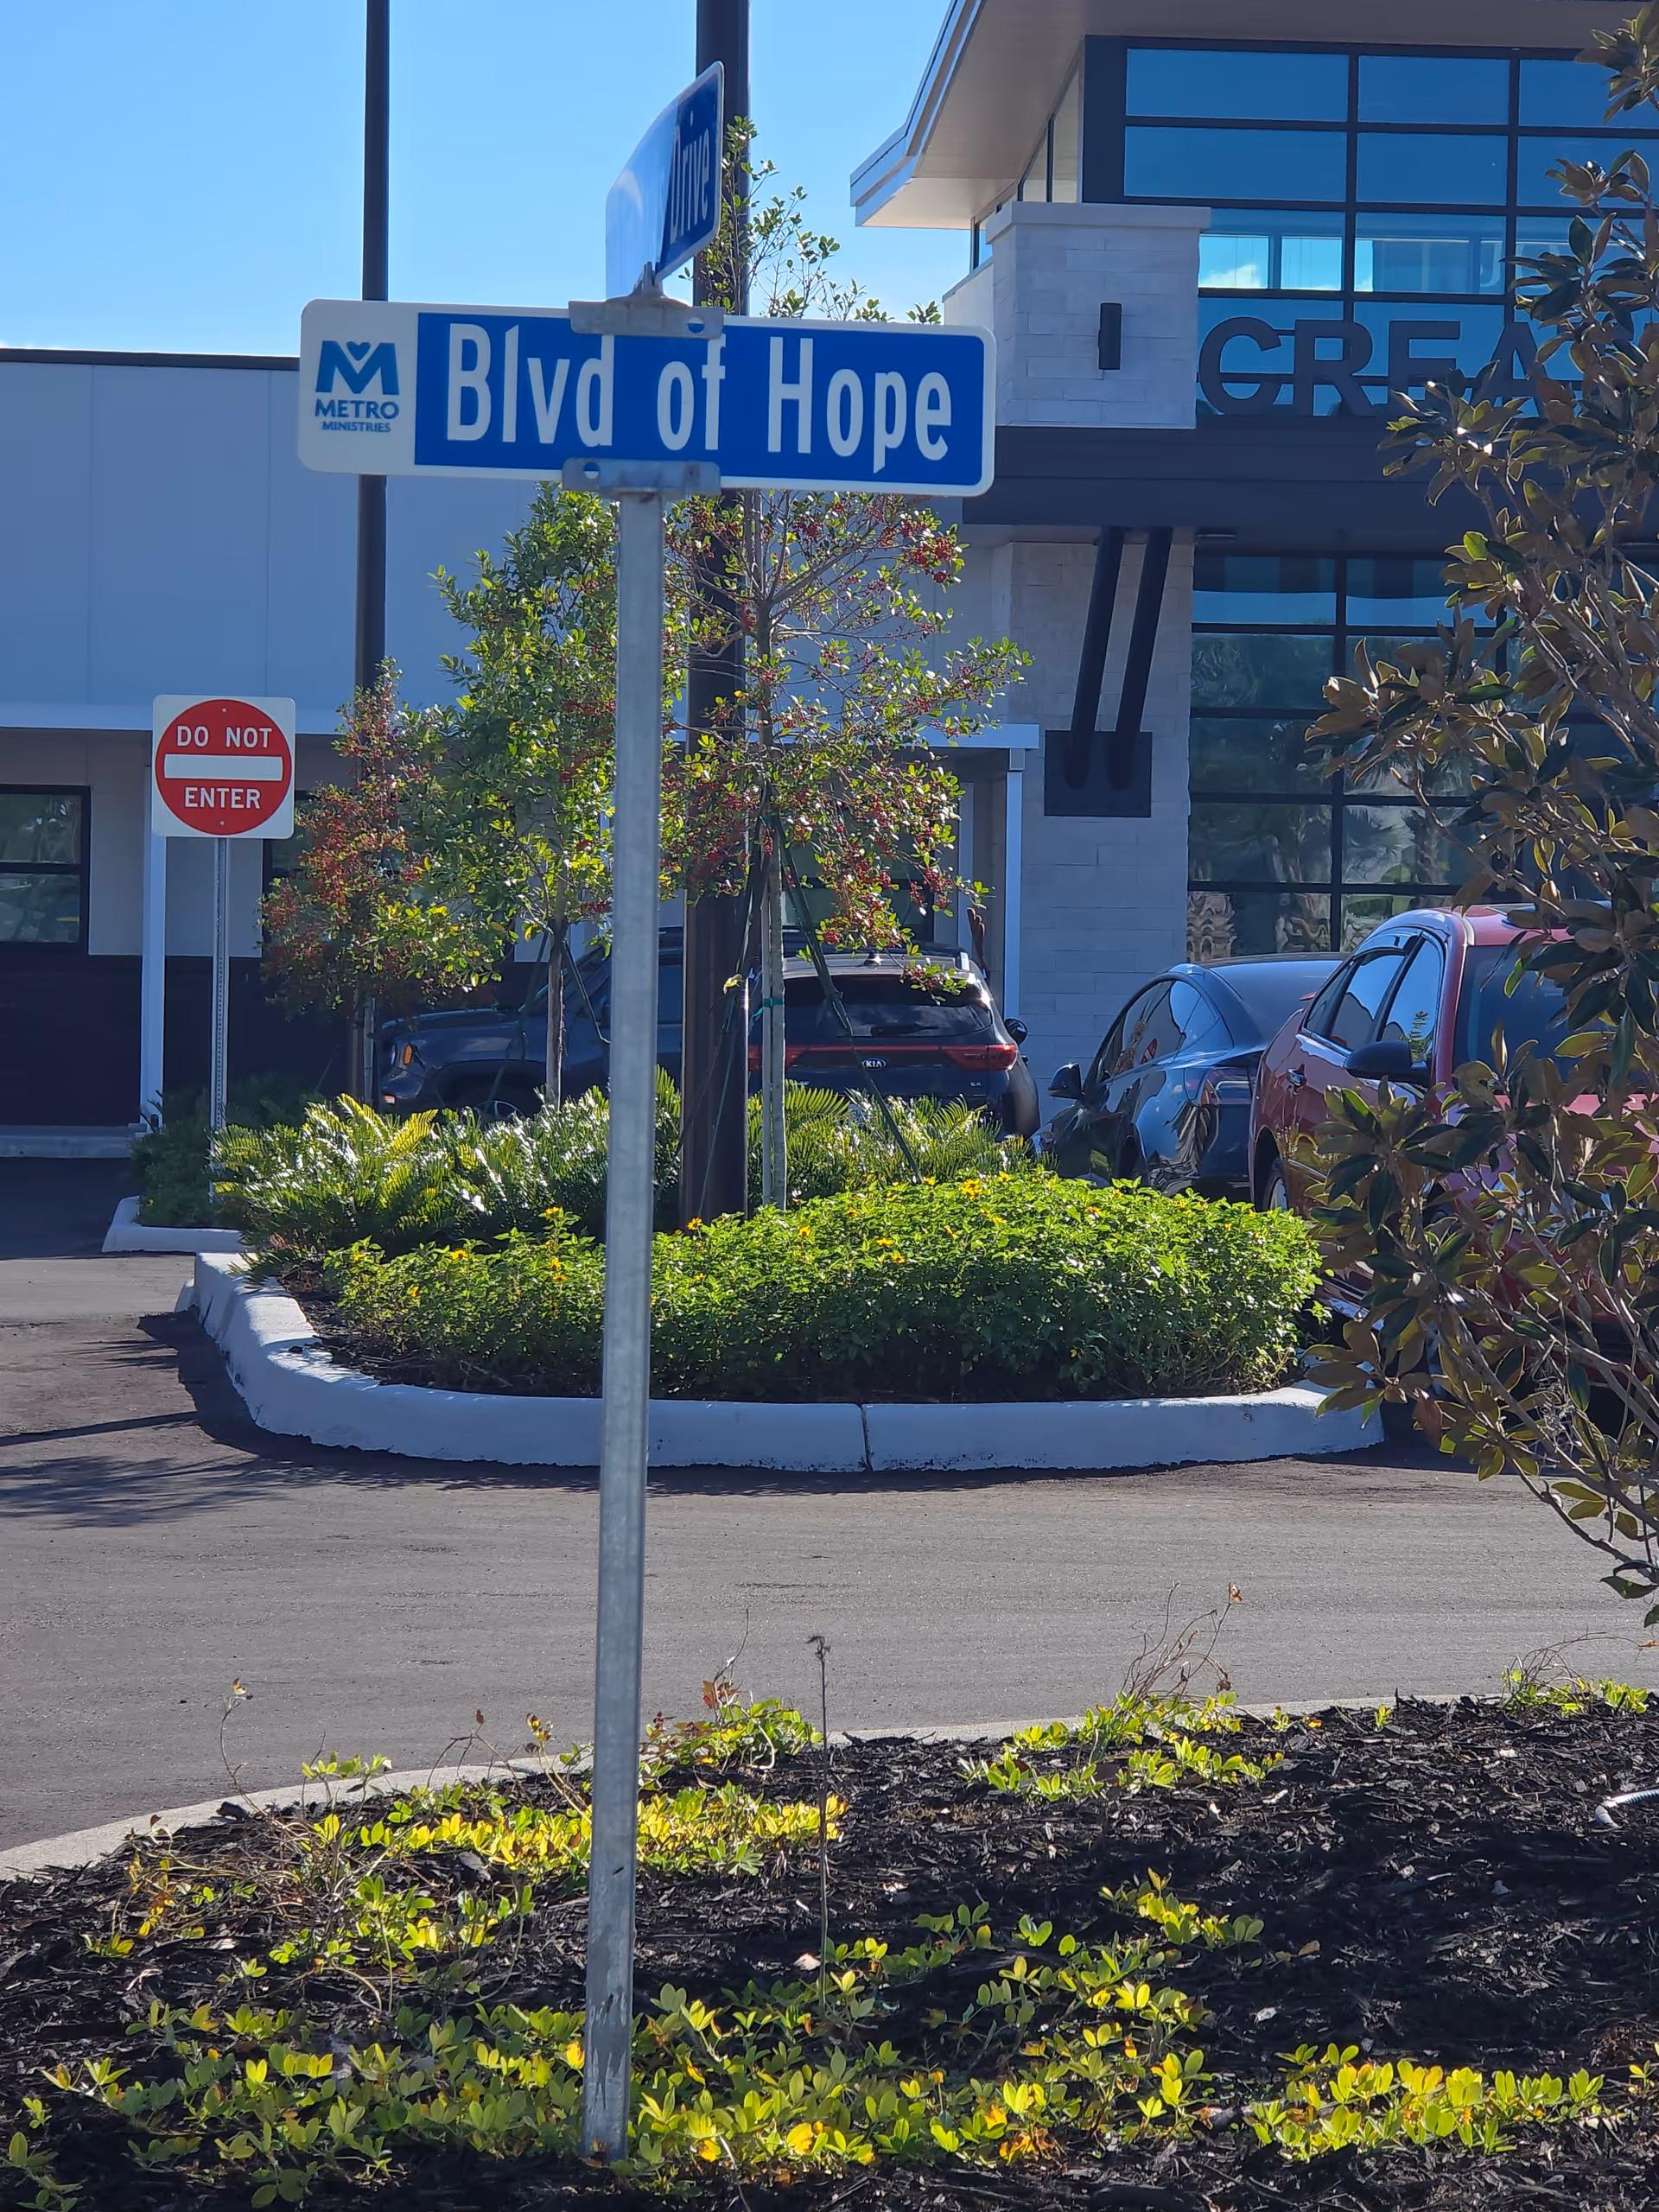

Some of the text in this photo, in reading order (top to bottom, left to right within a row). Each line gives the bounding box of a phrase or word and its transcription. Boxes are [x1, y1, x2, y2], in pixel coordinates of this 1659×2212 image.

[670, 110, 710, 245] Drive
[1198, 315, 1637, 418] CREA
[314, 397, 400, 420] METRO
[446, 322, 952, 474] Blvd of Hope
[321, 420, 391, 433] MINISTRIES
[176, 725, 273, 749] DO NOT
[184, 786, 262, 810] ENTER
